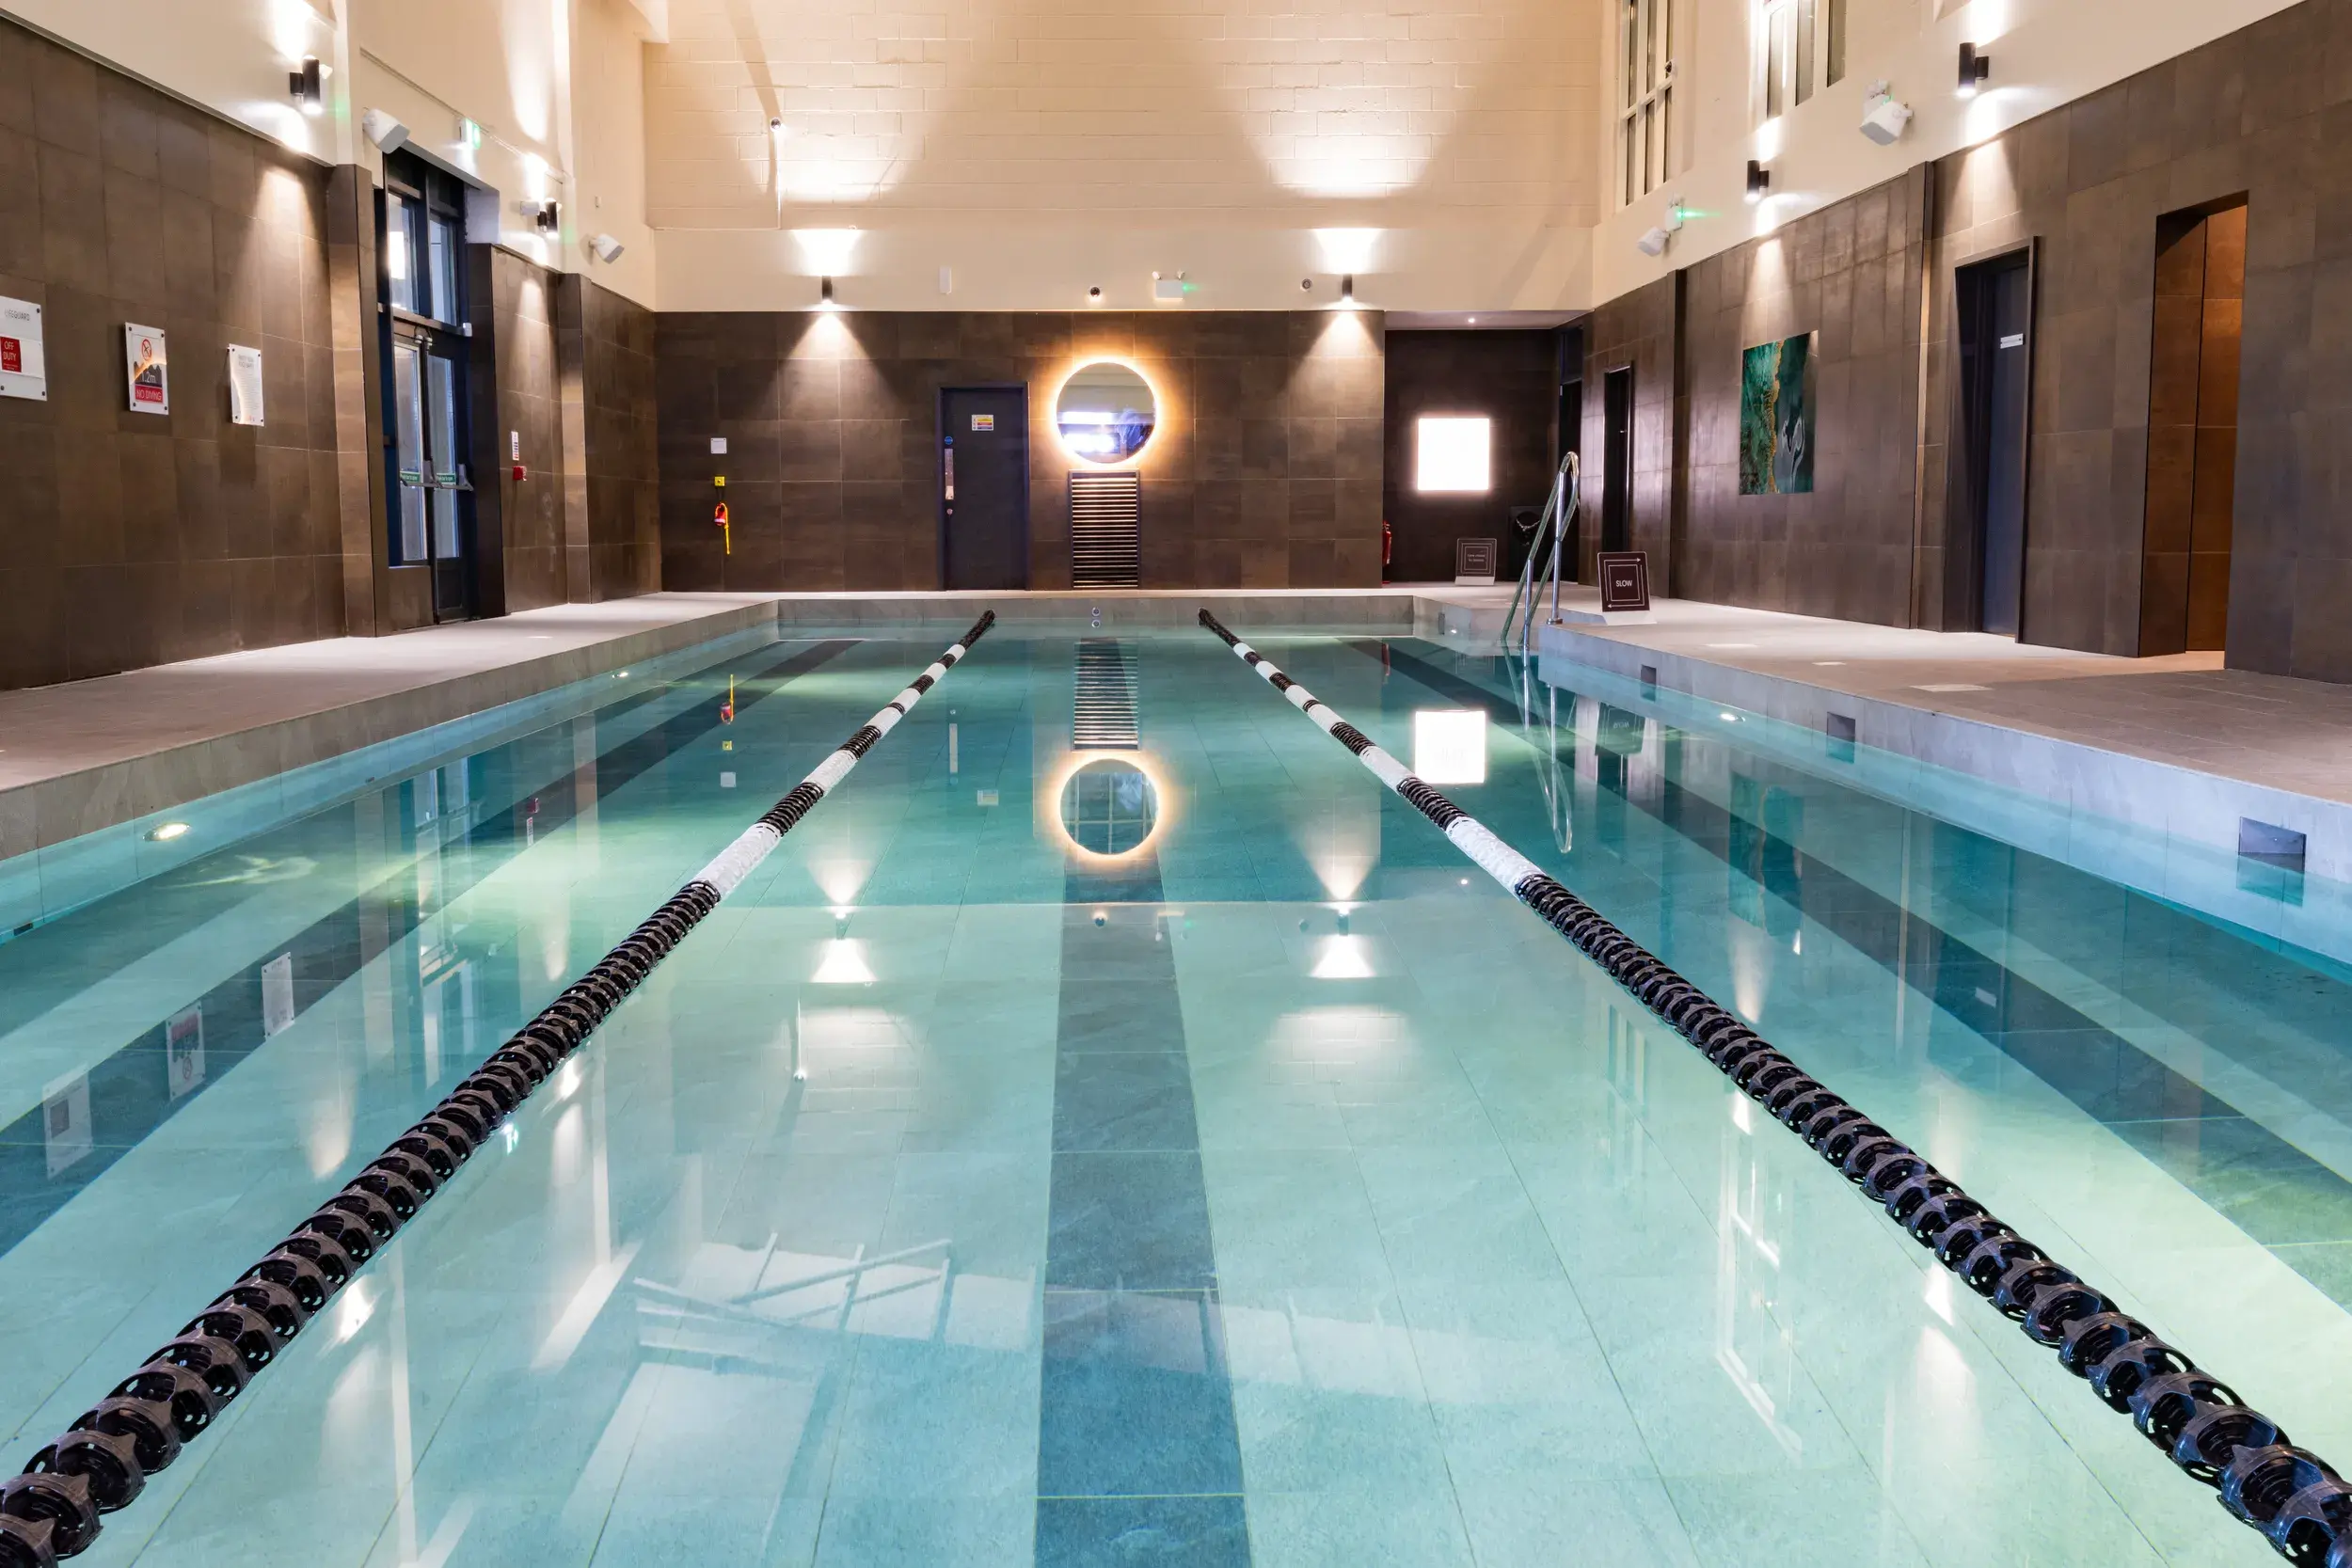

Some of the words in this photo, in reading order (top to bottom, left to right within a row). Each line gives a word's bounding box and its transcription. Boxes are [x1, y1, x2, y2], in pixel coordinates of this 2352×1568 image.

[4, 341, 14, 350] OFF
[3, 351, 16, 361] DUTY
[136, 388, 145, 399] NO
[145, 389, 162, 401] DIVING
[1615, 579, 1632, 588] SLOW
